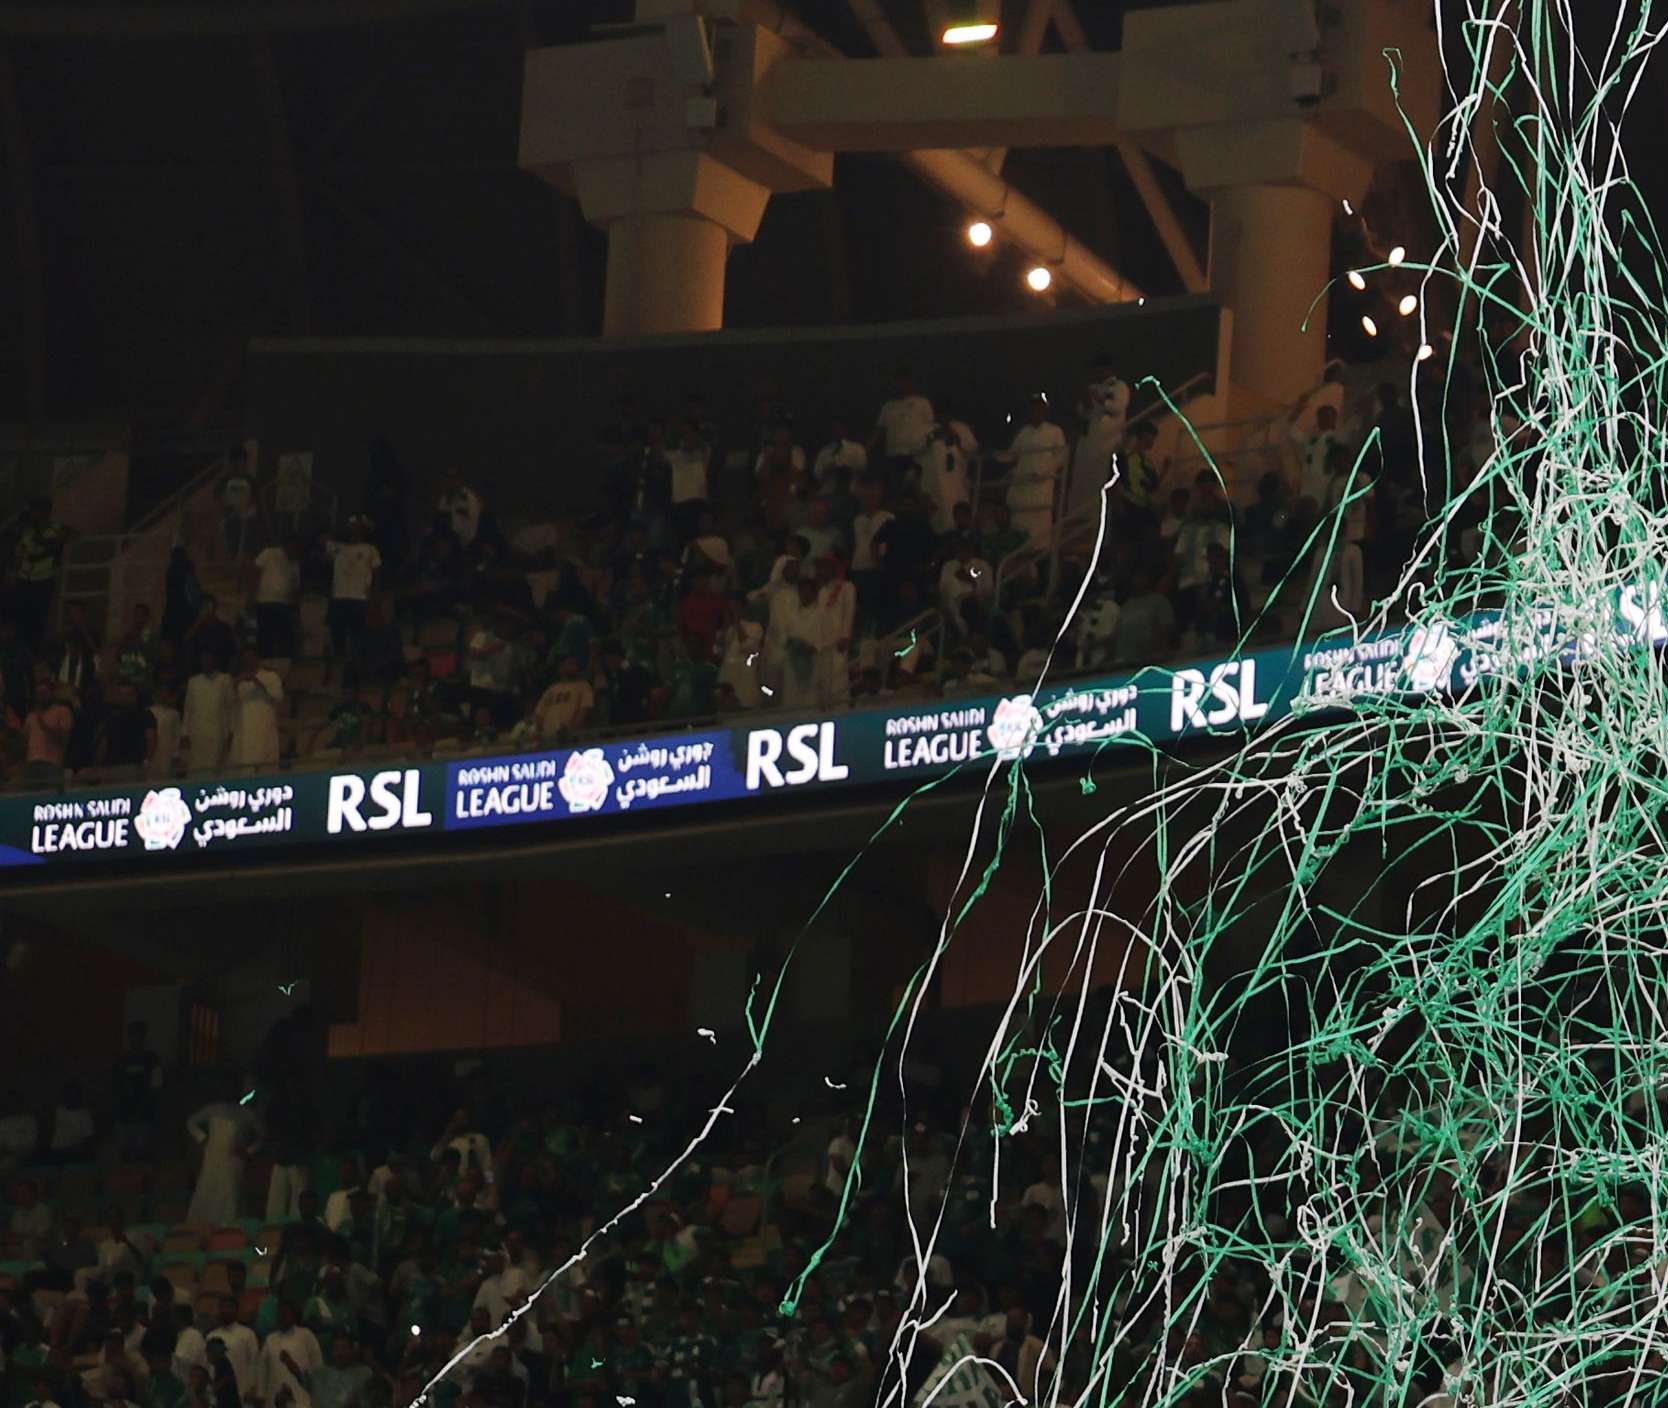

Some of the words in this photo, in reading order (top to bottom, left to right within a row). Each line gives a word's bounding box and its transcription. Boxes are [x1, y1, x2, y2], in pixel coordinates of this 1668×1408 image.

[1305, 660, 1399, 694] EAGUE
[1170, 658, 1269, 732] RSL
[885, 712, 939, 737] ROSHN
[940, 707, 986, 730] SAUDI
[1043, 708, 1137, 756] السعودي
[617, 741, 666, 772] روشن
[669, 741, 715, 767] دوري
[745, 721, 849, 791] RSL
[884, 729, 983, 769] LEAGUE
[457, 762, 509, 787] ROSHN
[511, 759, 557, 778] SAUDI
[615, 765, 712, 809] السعودي
[34, 802, 84, 821] ROSHN
[87, 797, 132, 816] SAUDI
[195, 785, 245, 812] روشن
[248, 785, 294, 805] دوري
[327, 768, 432, 834] RSL
[455, 785, 554, 819] LEAGUE
[32, 818, 129, 854] LEAGUE
[194, 807, 293, 848] السعودي
